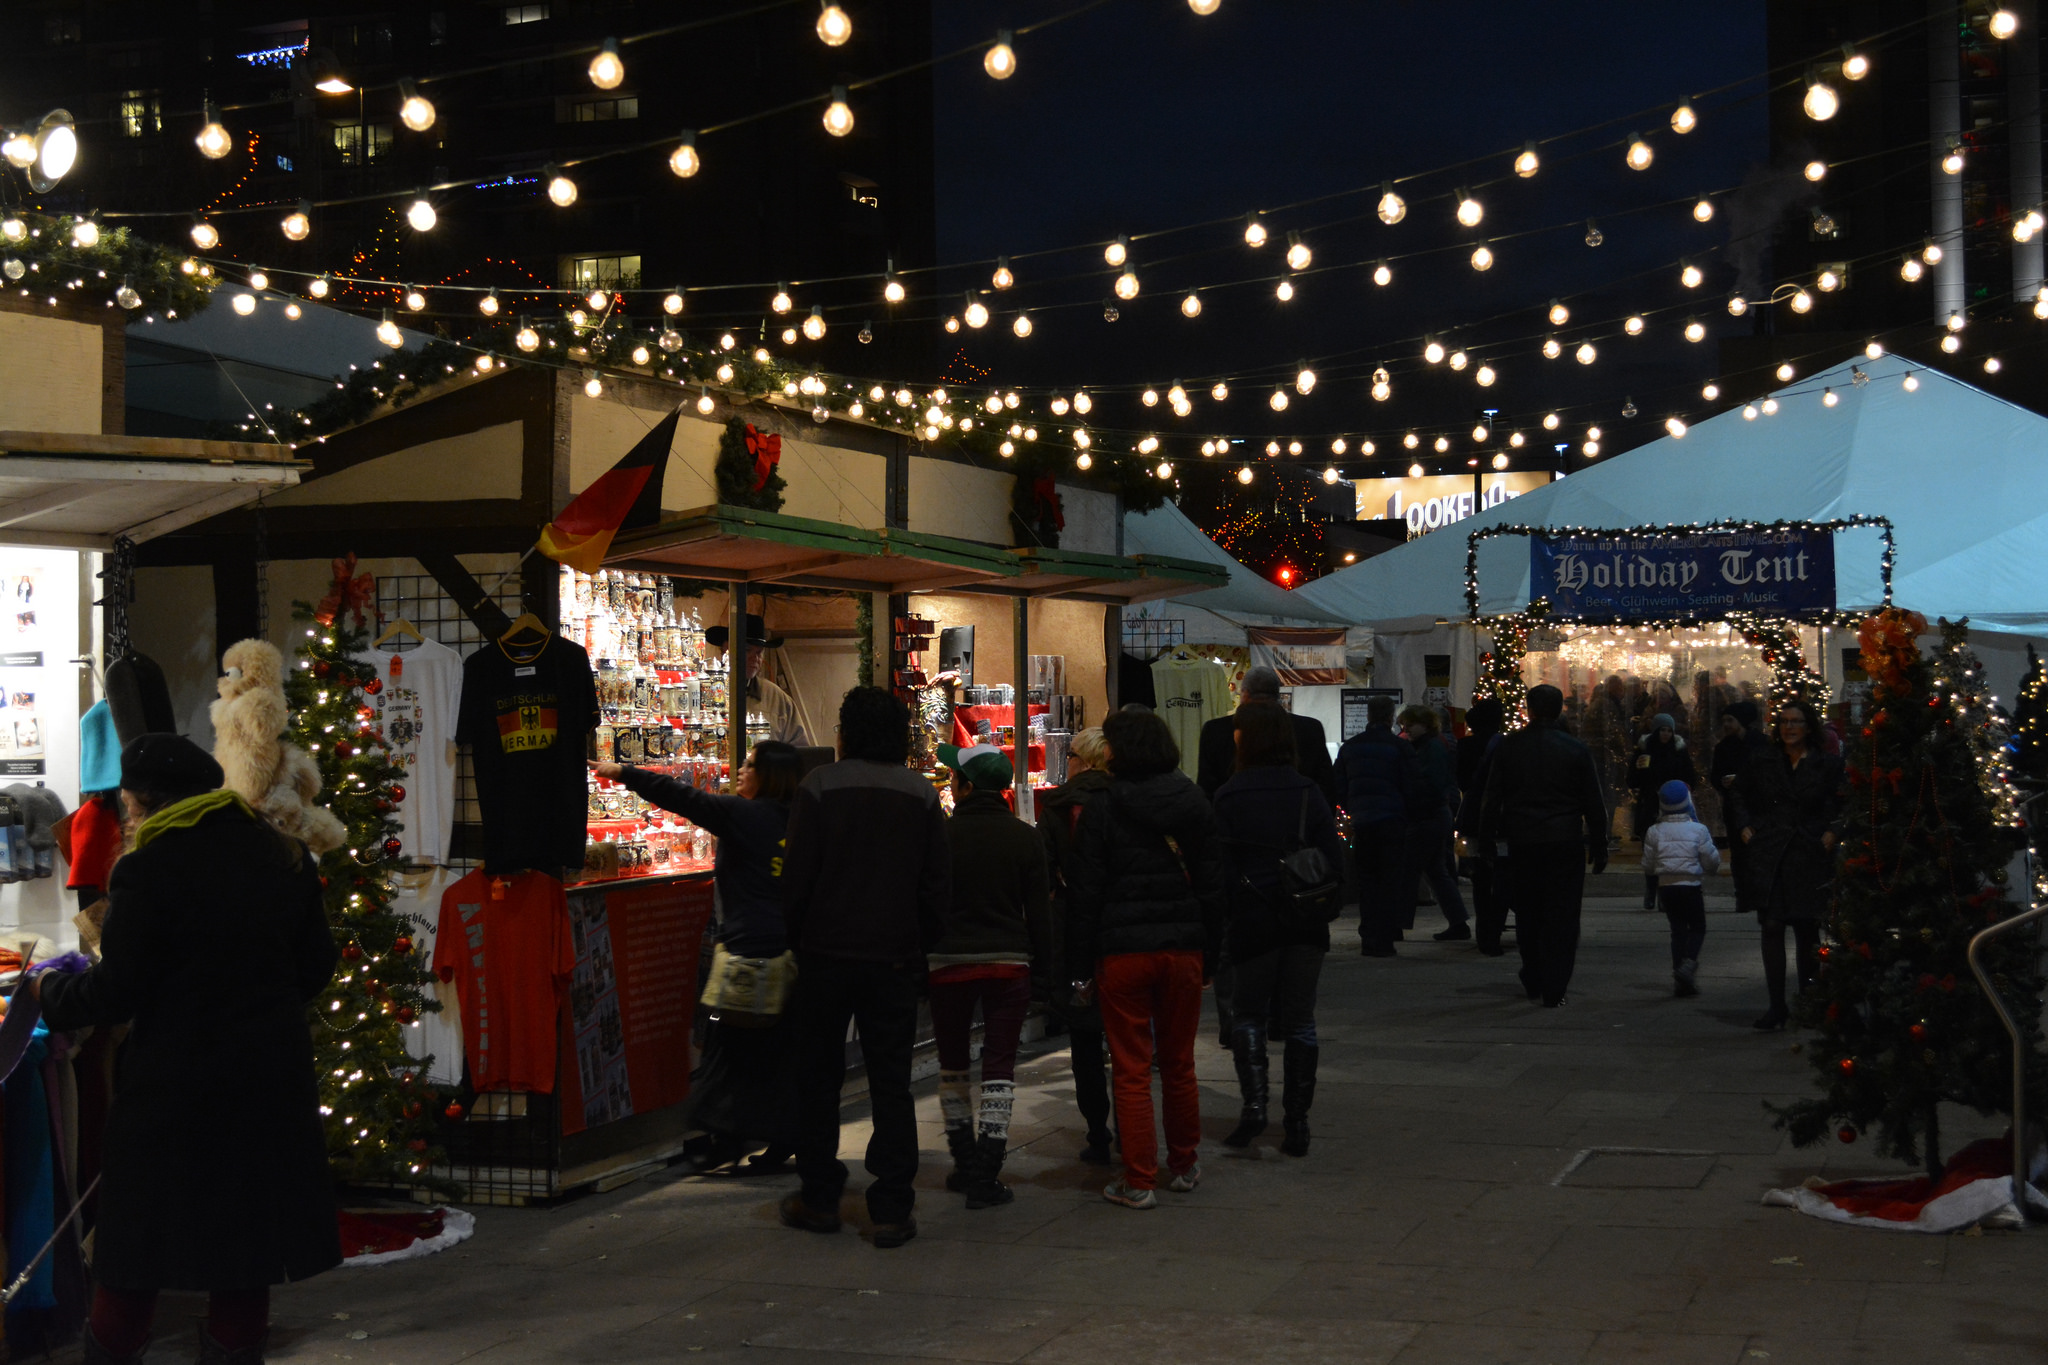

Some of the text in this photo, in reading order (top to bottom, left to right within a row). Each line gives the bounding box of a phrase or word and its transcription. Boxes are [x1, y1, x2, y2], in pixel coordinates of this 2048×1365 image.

[1560, 540, 1595, 551] Warm
[1599, 540, 1613, 552] up
[1616, 540, 1627, 551] in
[1631, 539, 1647, 551] the
[1553, 549, 1809, 595] Holiday Tent
[1585, 591, 1779, 607] Beer Glühwein Seating Music
